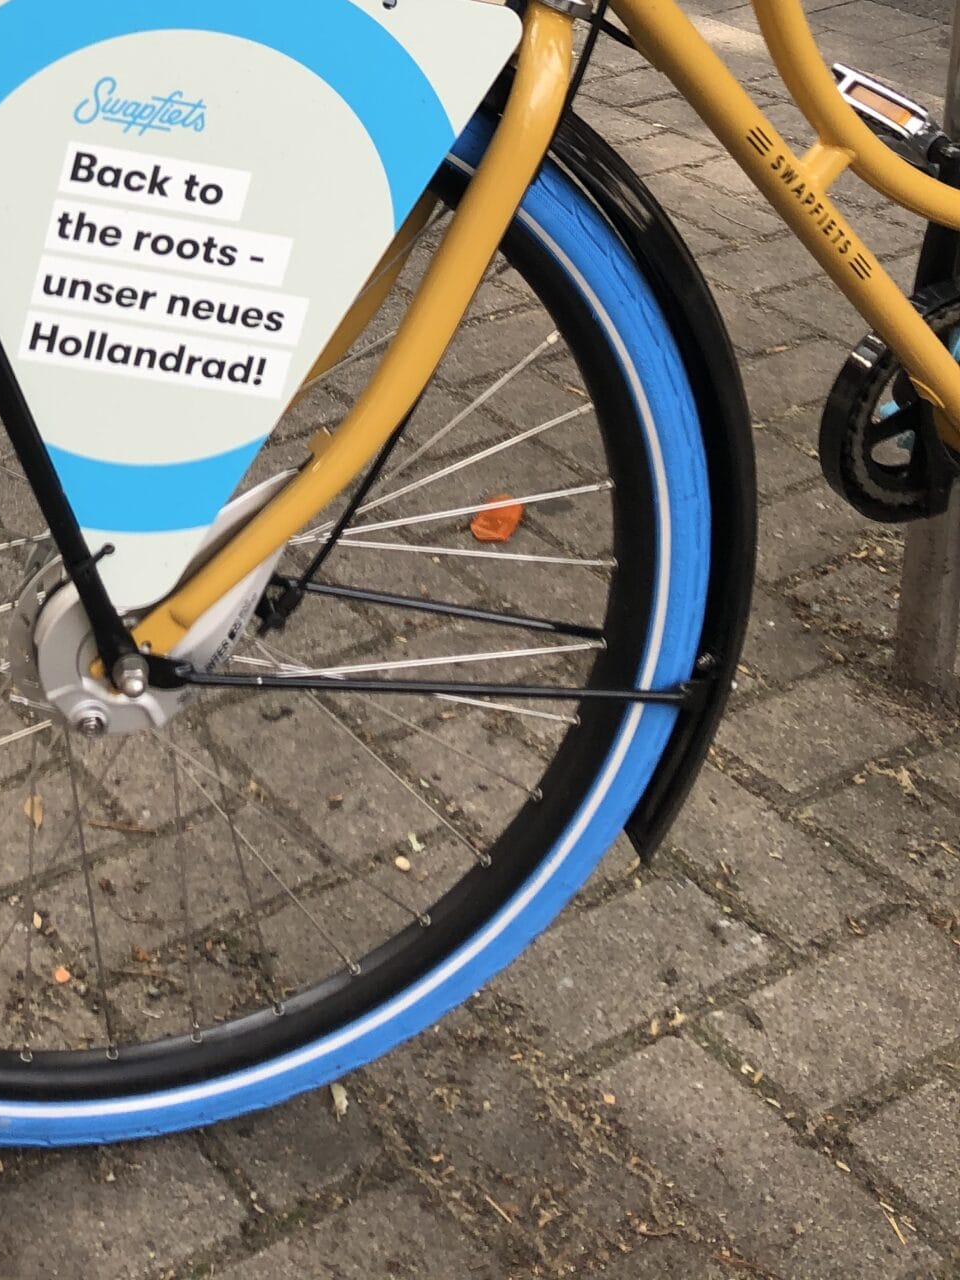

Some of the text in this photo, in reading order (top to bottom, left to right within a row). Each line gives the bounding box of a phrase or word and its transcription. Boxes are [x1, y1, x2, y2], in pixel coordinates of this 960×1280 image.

[72, 76, 208, 136] Swapfiets
[69, 151, 224, 206] Back to
[771, 155, 852, 255] SWAPFIETS
[56, 211, 123, 247] the
[133, 229, 239, 267] roots
[42, 273, 286, 333] unser neues
[28, 322, 267, 386] Hollandrad!
